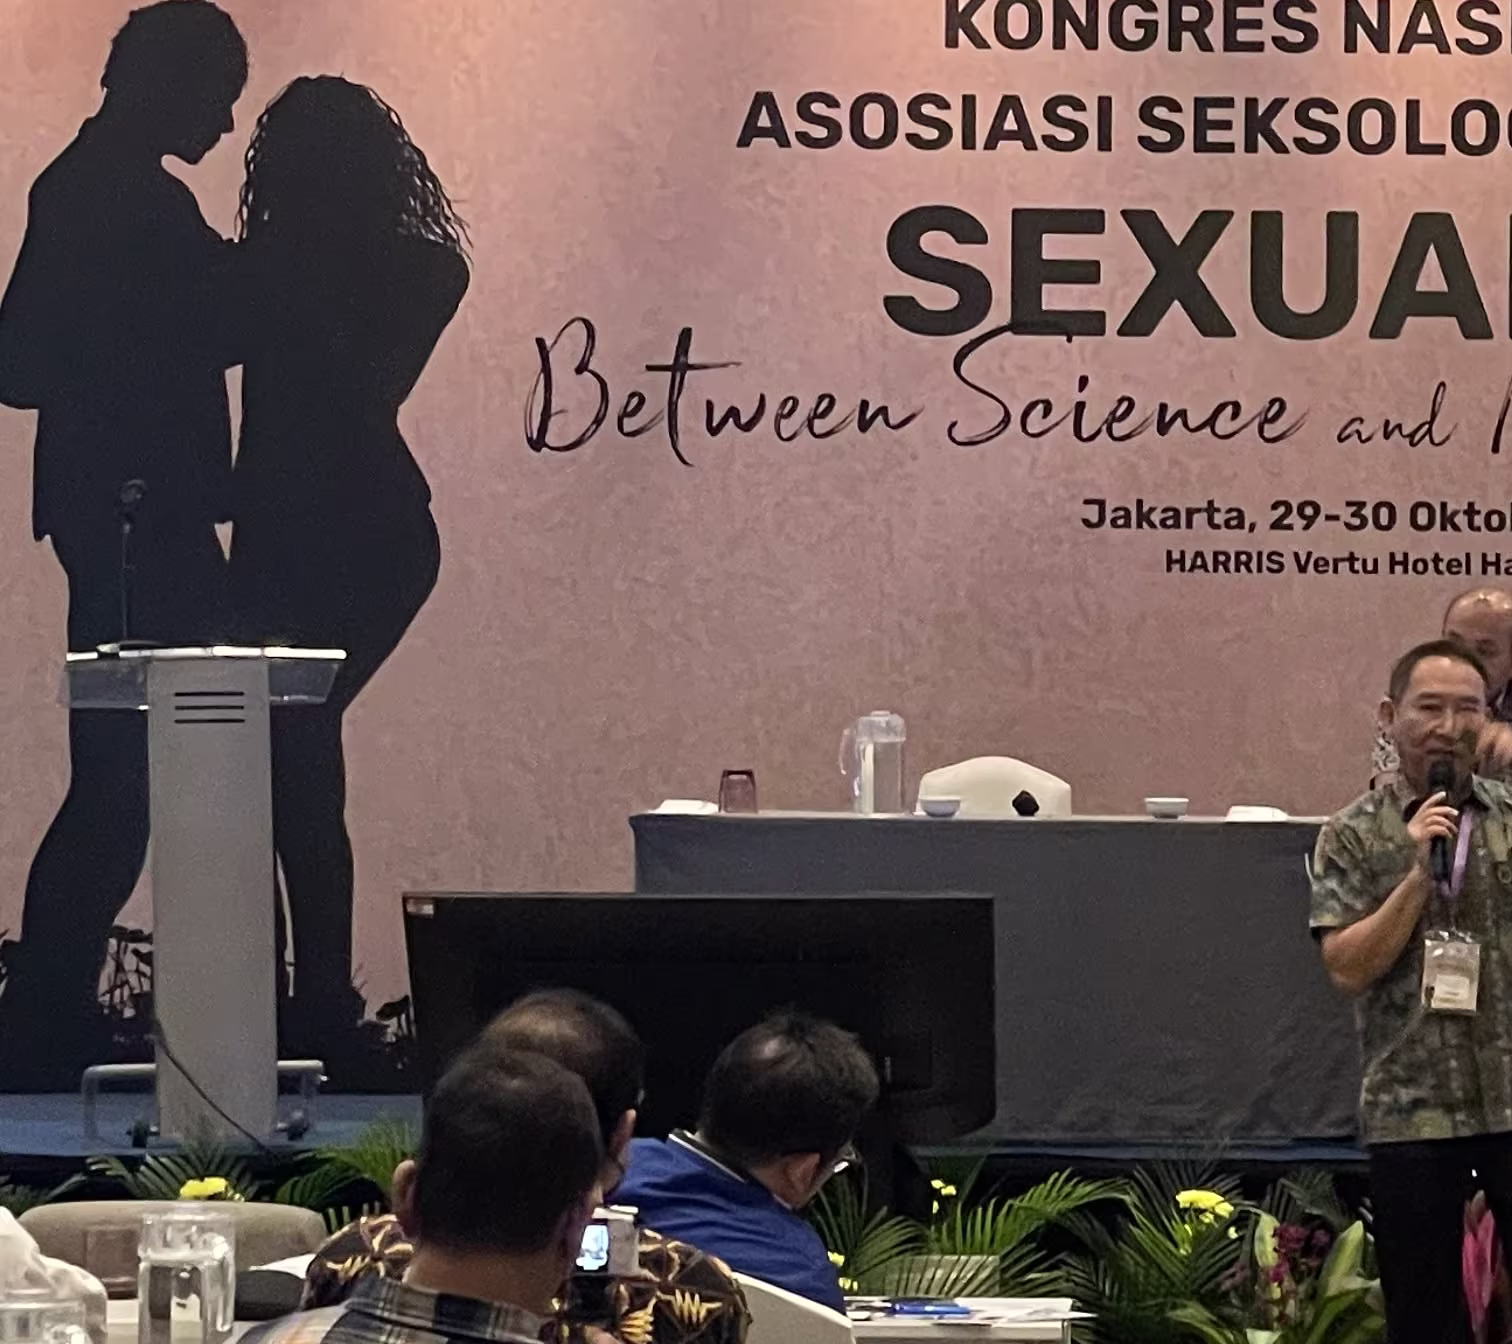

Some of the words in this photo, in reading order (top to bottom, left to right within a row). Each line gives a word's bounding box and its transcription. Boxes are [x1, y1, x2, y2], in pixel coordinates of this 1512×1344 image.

[736, 91, 1113, 153] ASOSIASI
[524, 316, 925, 468] Between
[946, 321, 1309, 447] Science
[1336, 380, 1460, 448] and
[1080, 498, 1257, 534] Jakarta,
[1269, 499, 1397, 532] 29-30
[1165, 549, 1286, 574] HARRIS
[1292, 550, 1379, 576] Vertu
[1388, 551, 1472, 576] Hotel
